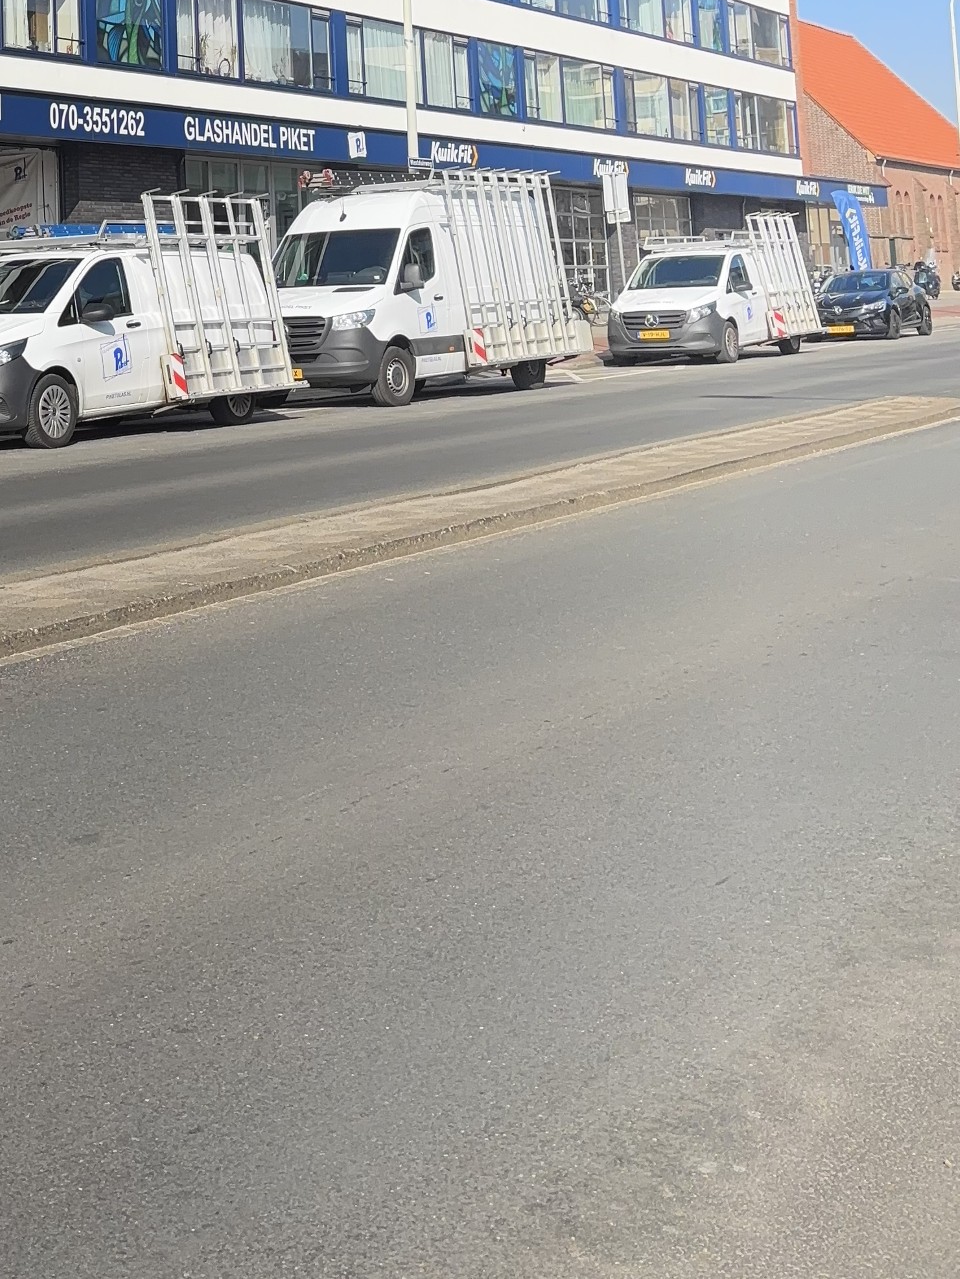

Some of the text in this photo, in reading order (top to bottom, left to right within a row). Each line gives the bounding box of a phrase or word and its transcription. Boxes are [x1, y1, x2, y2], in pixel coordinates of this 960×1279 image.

[50, 102, 145, 136] 070-3551262
[184, 116, 277, 149] GLASHANDEL
[280, 126, 316, 152] PIKET
